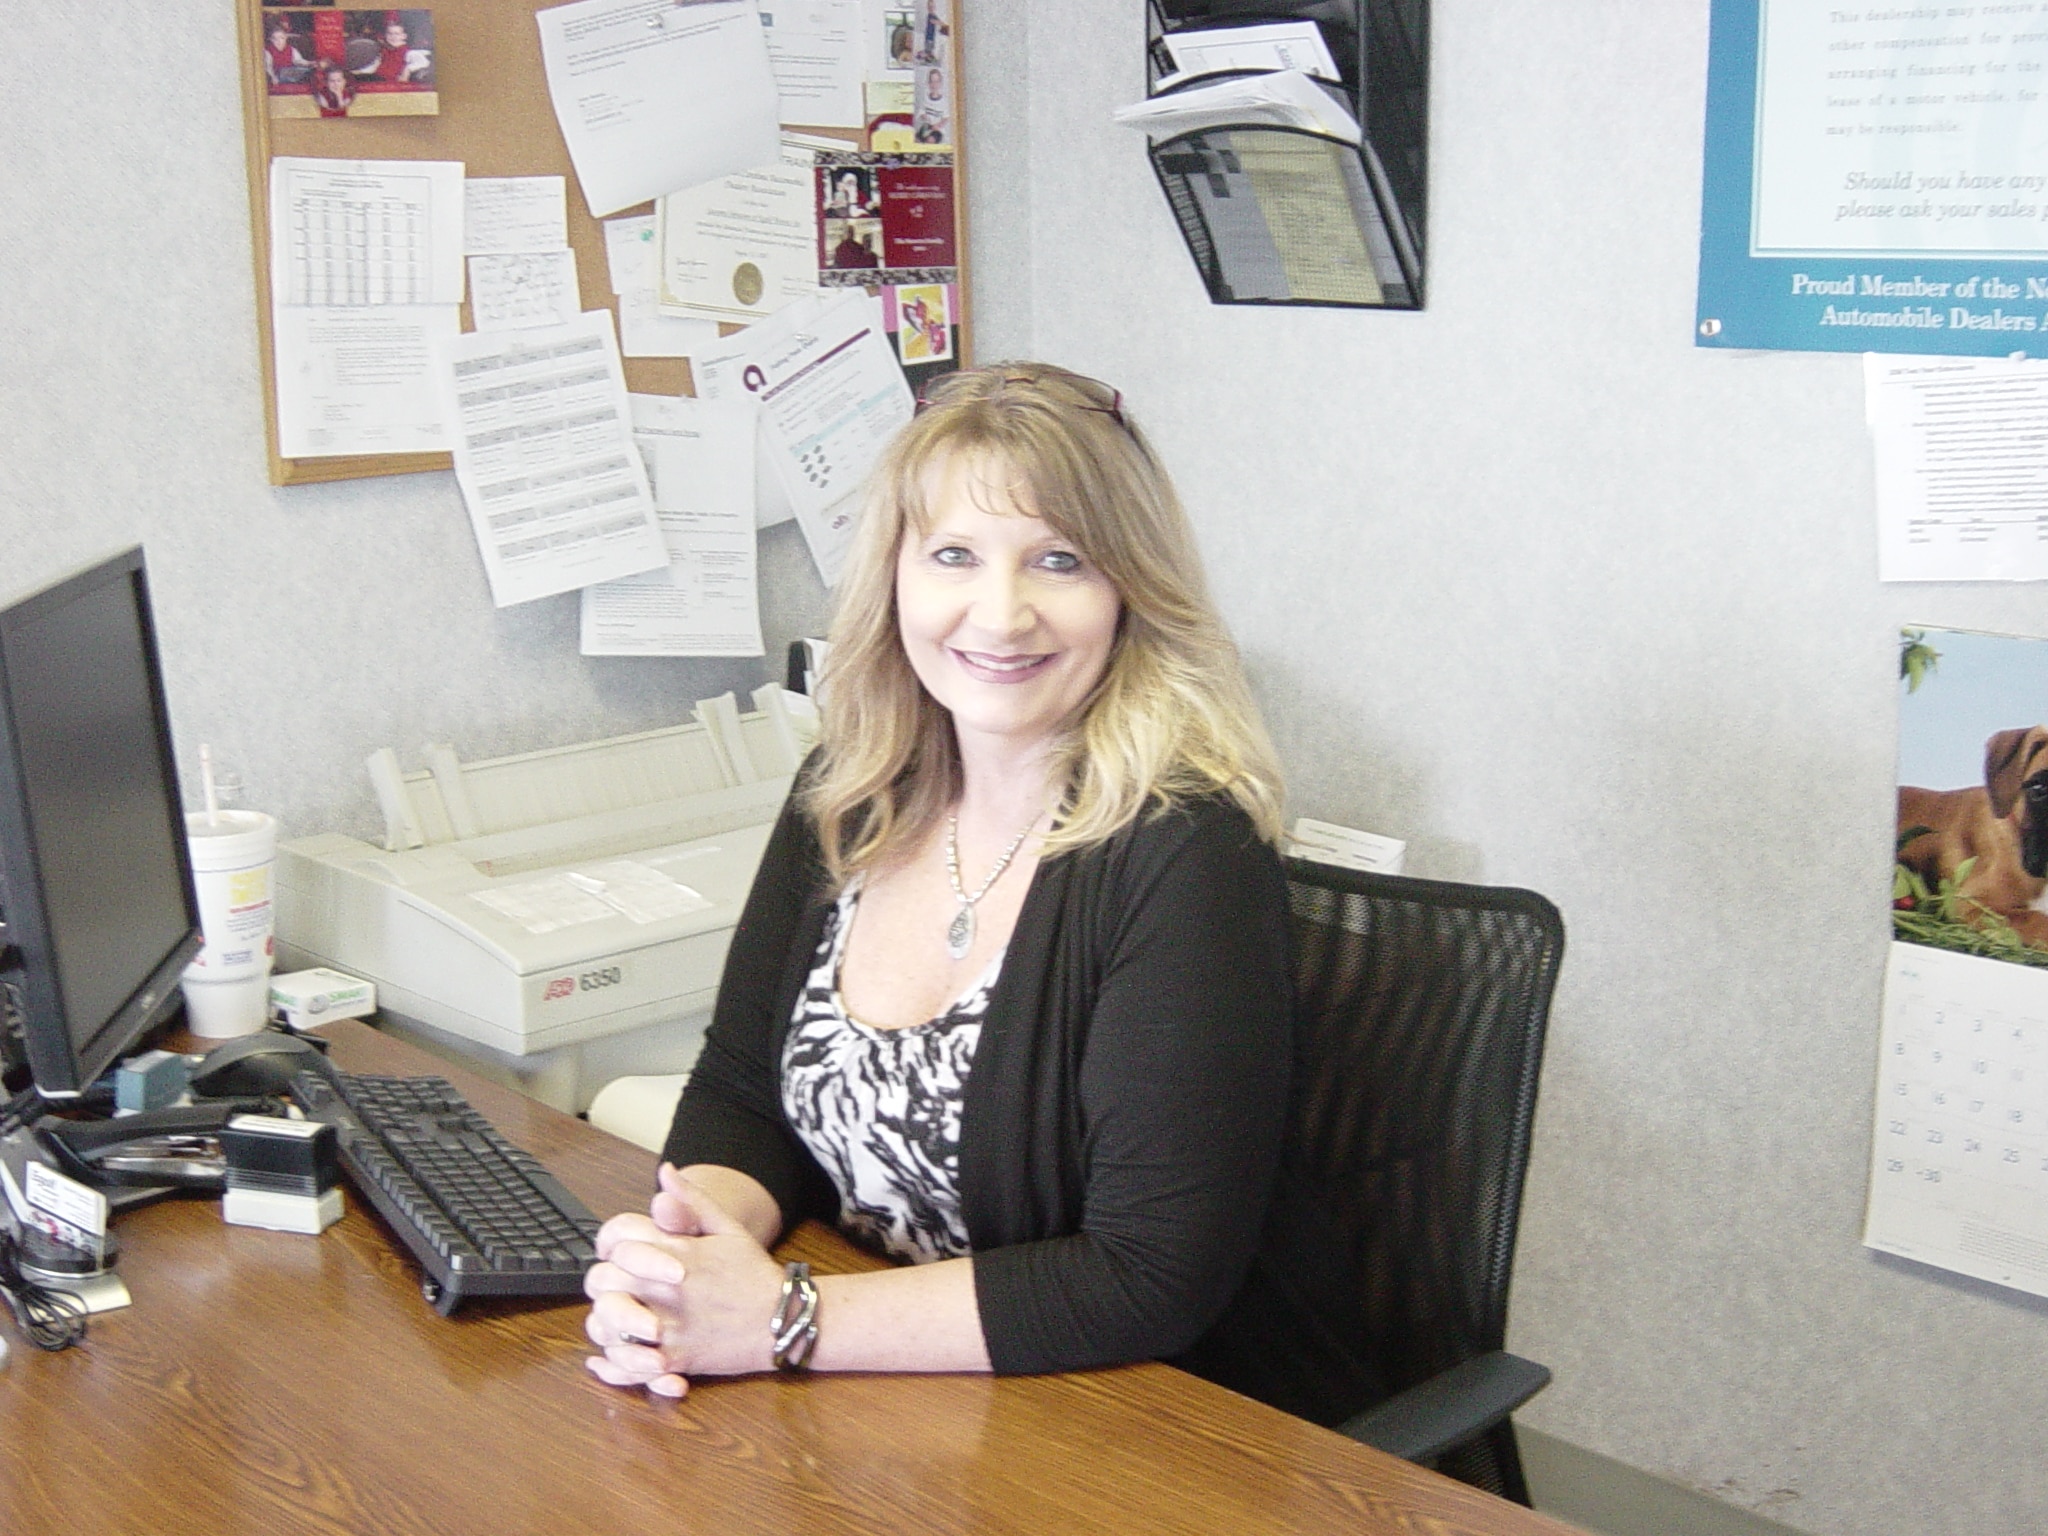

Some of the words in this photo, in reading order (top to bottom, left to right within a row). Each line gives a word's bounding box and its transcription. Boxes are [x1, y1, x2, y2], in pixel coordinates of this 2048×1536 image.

[1979, 32, 2001, 44] for
[1844, 171, 1913, 191] Should
[1916, 175, 1957, 193] you
[1959, 171, 2005, 190] have
[2008, 175, 2047, 193] any
[1835, 200, 1896, 222] please
[1898, 200, 1933, 218] ask
[1935, 204, 1981, 222] your
[1986, 198, 2037, 218] sales
[1791, 273, 1855, 296] Proud
[1860, 274, 1952, 298] Member
[1954, 276, 1981, 298] of
[1982, 277, 2020, 299] the
[2024, 277, 2048, 300] N
[1819, 304, 1945, 329] Automobile
[1948, 307, 2037, 331] Dealers
[579, 966, 622, 992] 6350
